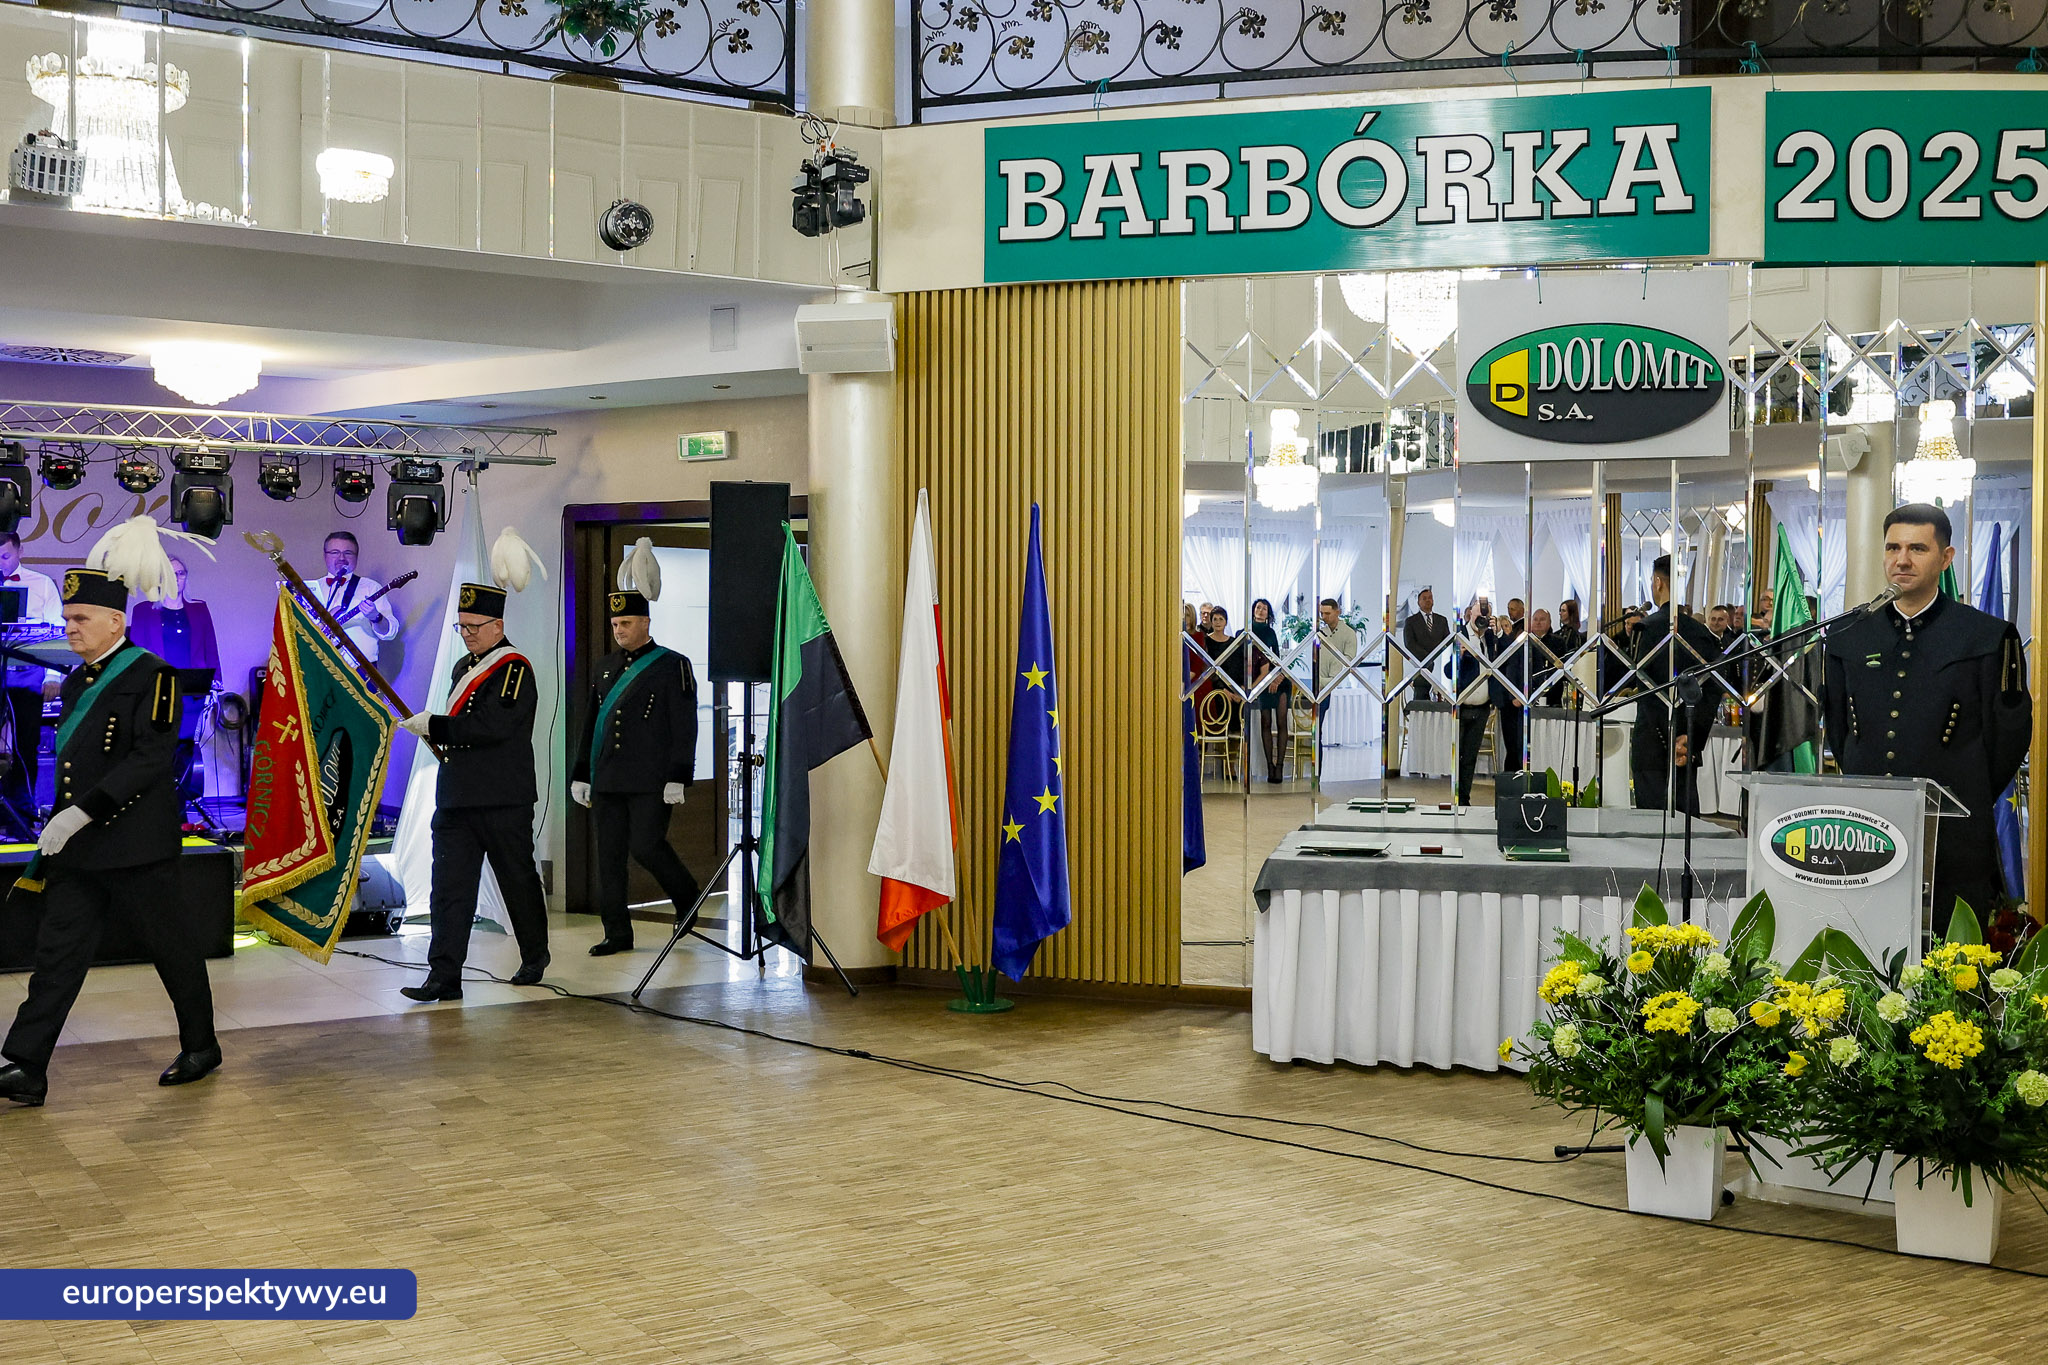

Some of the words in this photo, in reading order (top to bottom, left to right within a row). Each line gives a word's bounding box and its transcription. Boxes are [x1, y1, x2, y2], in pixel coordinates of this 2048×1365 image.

[999, 111, 1695, 241] BARBÓRKA
[1774, 126, 2048, 222] 2025
[1537, 337, 1714, 392] DOLOMIT
[1496, 383, 1525, 402] D
[1537, 403, 1594, 421] S.A.
[1820, 808, 1846, 816] Kopalnia
[1810, 823, 1888, 854] DOLOMIT
[1791, 846, 1801, 856] D
[1811, 855, 1833, 865] S.A.
[1795, 872, 1869, 886] www.dolomit.com.pl
